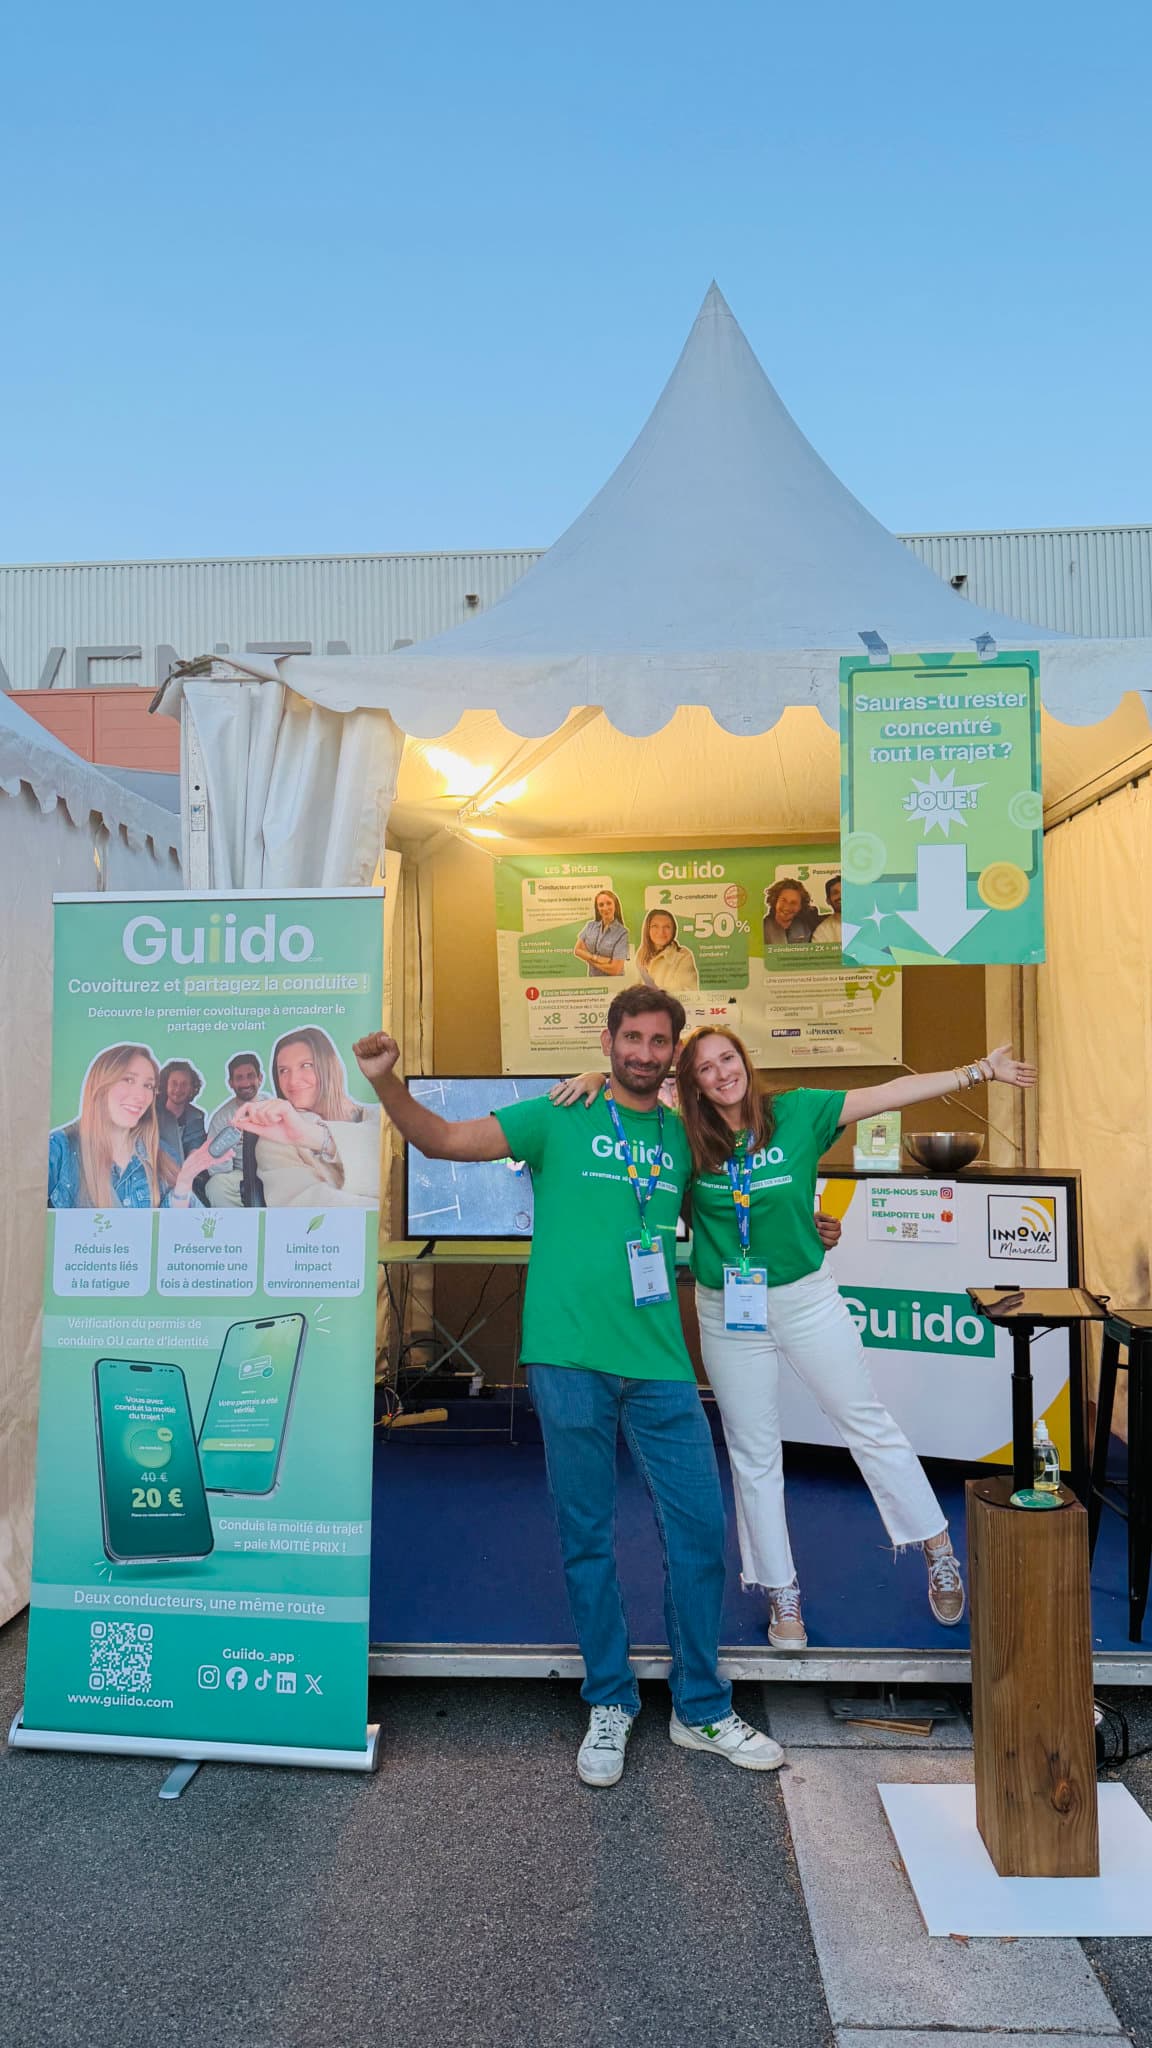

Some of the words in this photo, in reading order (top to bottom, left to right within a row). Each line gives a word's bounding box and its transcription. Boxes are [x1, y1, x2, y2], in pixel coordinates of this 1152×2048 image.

[855, 693, 960, 712] Sauras-tu
[964, 691, 1026, 709] rester
[884, 716, 993, 738] concentré
[870, 744, 912, 763] tout
[917, 744, 935, 761] le
[938, 743, 997, 764] trajet
[1001, 743, 1013, 760] ?
[561, 863, 571, 875] 3
[658, 861, 725, 880] Guiido
[798, 866, 809, 881] 3
[528, 881, 535, 895] 1
[659, 889, 672, 904] 2
[122, 913, 315, 965] Guiido
[68, 978, 160, 994] Covoiturez
[164, 978, 180, 992] et
[184, 977, 261, 996] partagez
[264, 976, 279, 991] la
[282, 974, 359, 991] conduite
[363, 974, 368, 989] !
[88, 1006, 142, 1018] Découvre
[144, 1006, 155, 1017] le
[156, 1006, 201, 1019] premier
[203, 1005, 271, 1019] covoiturage
[273, 1004, 280, 1016] à
[282, 1004, 333, 1016] encadrer
[335, 1004, 346, 1015] le
[167, 1021, 211, 1034] partage
[214, 1020, 228, 1032] de
[230, 1020, 266, 1032] volant
[871, 1187, 918, 1197] SUIS-NOUS
[919, 1189, 938, 1197] SUR
[871, 1198, 887, 1207] ET
[872, 1210, 920, 1220] REMPORTE
[922, 1211, 935, 1220] UN
[74, 1242, 111, 1254] Réduis
[113, 1243, 129, 1254] les
[173, 1243, 222, 1255] Préserve
[224, 1244, 242, 1254] ton
[286, 1243, 319, 1254] Limite
[321, 1244, 340, 1254] ton
[1000, 1242, 1053, 1256] Marseille
[64, 1260, 117, 1272] accidents
[119, 1260, 138, 1272] liés
[167, 1260, 224, 1272] autonomie
[225, 1263, 248, 1272] une
[294, 1260, 332, 1273] impact
[71, 1278, 77, 1289] à
[79, 1278, 89, 1289] la
[91, 1278, 130, 1291] fatigue
[160, 1278, 180, 1289] fois
[182, 1278, 188, 1289] à
[191, 1278, 254, 1289] destination
[267, 1278, 360, 1290] environnemental
[68, 1318, 129, 1329] Vérification
[131, 1318, 146, 1329] du
[147, 1318, 187, 1331] permis
[189, 1318, 201, 1329] de
[57, 1335, 104, 1346] conduire
[106, 1336, 124, 1346] OU
[126, 1336, 155, 1346] carte
[157, 1335, 209, 1347] d'identité
[140, 1472, 156, 1483] 40
[160, 1472, 168, 1483] €
[131, 1488, 161, 1508] 20
[168, 1488, 184, 1508] €
[219, 1519, 265, 1532] Conduis
[267, 1520, 277, 1532] la
[279, 1519, 314, 1533] moitié
[316, 1521, 330, 1533] du
[332, 1522, 364, 1537] trajet
[243, 1539, 268, 1553] paie
[270, 1536, 310, 1551] MOITIÉ
[312, 1541, 339, 1552] PRIX
[74, 1590, 111, 1605] Deux
[113, 1592, 207, 1611] conducteurs,
[210, 1599, 236, 1611] une
[240, 1597, 284, 1612] même
[287, 1601, 326, 1615] route
[222, 1648, 295, 1664] Guiido_app
[68, 1693, 174, 1709] www.guiido.com
